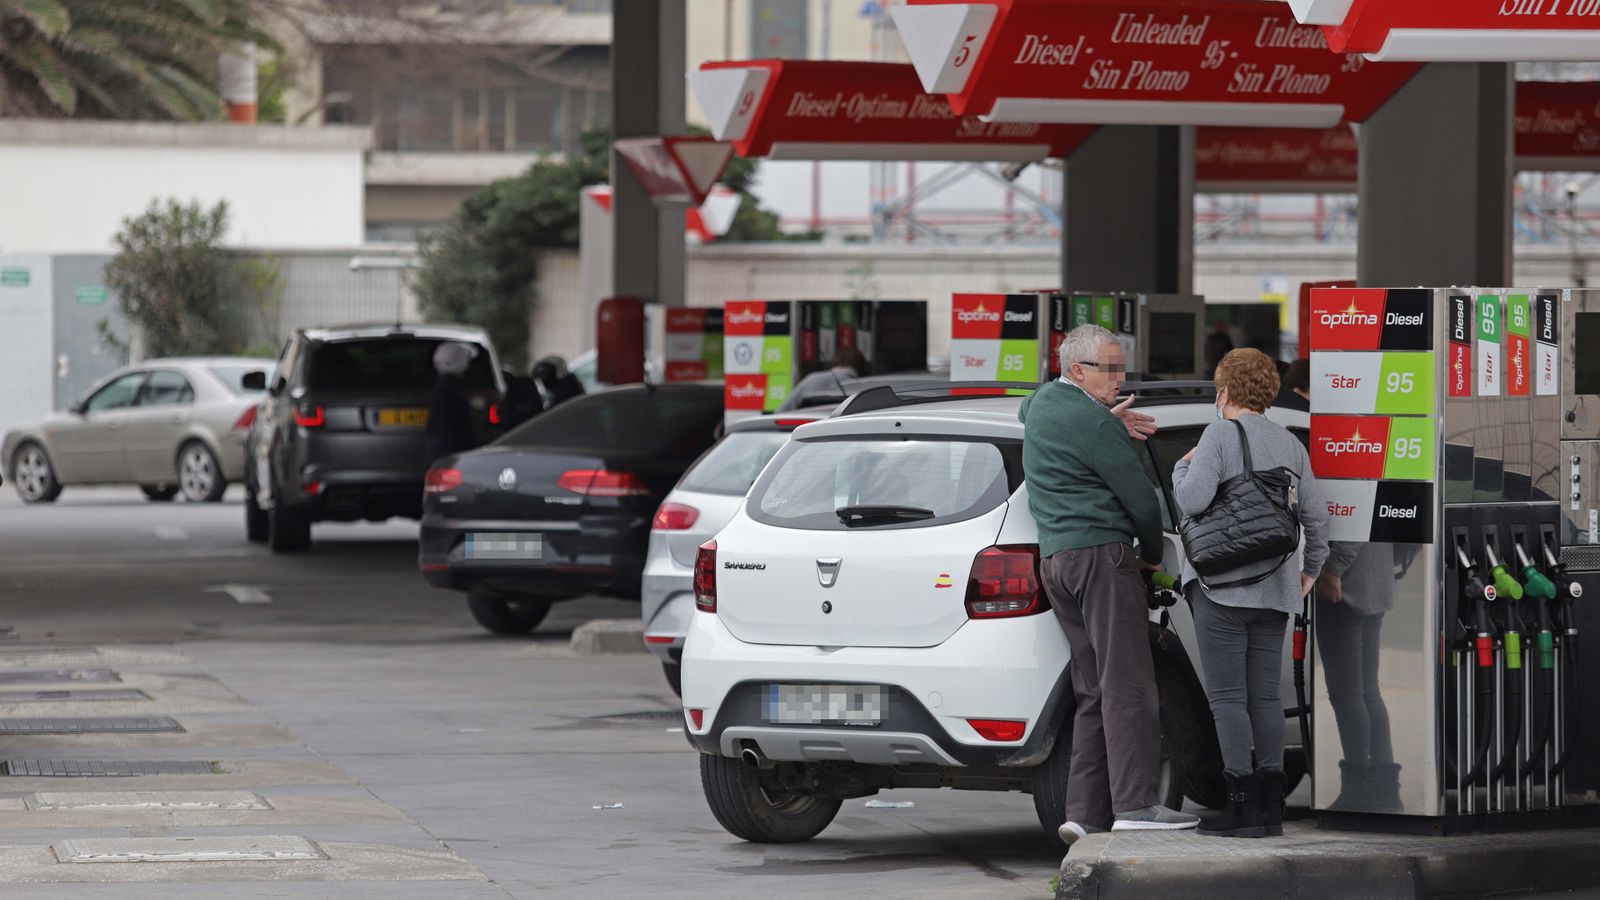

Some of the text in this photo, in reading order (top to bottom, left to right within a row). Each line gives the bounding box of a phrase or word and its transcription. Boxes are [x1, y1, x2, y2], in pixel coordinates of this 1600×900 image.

[1111, 13, 1211, 45] Unleaded
[953, 35, 976, 67] 5
[1082, 59, 1190, 91] Sin Plomo
[1227, 63, 1331, 95] Sin Plomo
[738, 90, 754, 116] 9
[908, 95, 956, 119] Diese
[958, 310, 1033, 324] optima Diesel
[1320, 311, 1424, 329] optima Diesel
[1455, 299, 1464, 340] Diesel
[1482, 302, 1495, 335] 95
[1514, 304, 1524, 327] 95
[1543, 299, 1552, 340] Diesel
[964, 354, 1025, 371] star 95
[1457, 346, 1465, 391] optima
[1515, 339, 1524, 386] optima
[1331, 371, 1415, 393] star 95
[1325, 438, 1423, 459] optima 95
[1327, 503, 1417, 519] star Diesel
